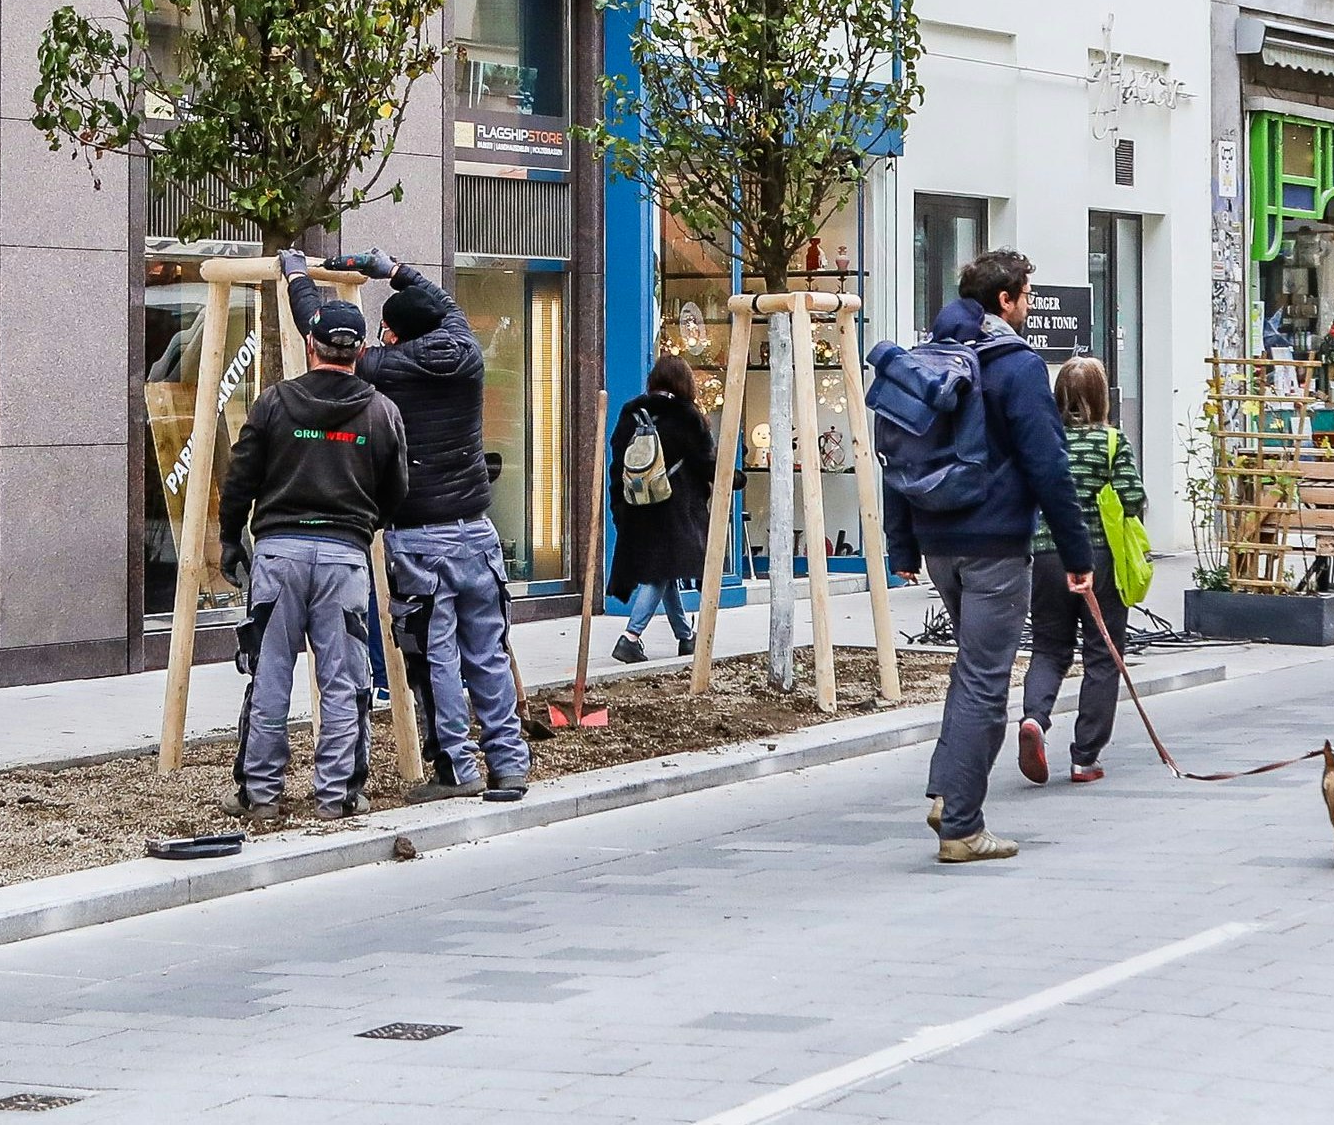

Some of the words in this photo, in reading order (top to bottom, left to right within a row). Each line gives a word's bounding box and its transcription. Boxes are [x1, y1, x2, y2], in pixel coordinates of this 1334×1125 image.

[1026, 315, 1044, 329] GIN
[1043, 316, 1051, 330] &
[1051, 316, 1079, 330] TONIC
[1026, 334, 1048, 348] CAFE
